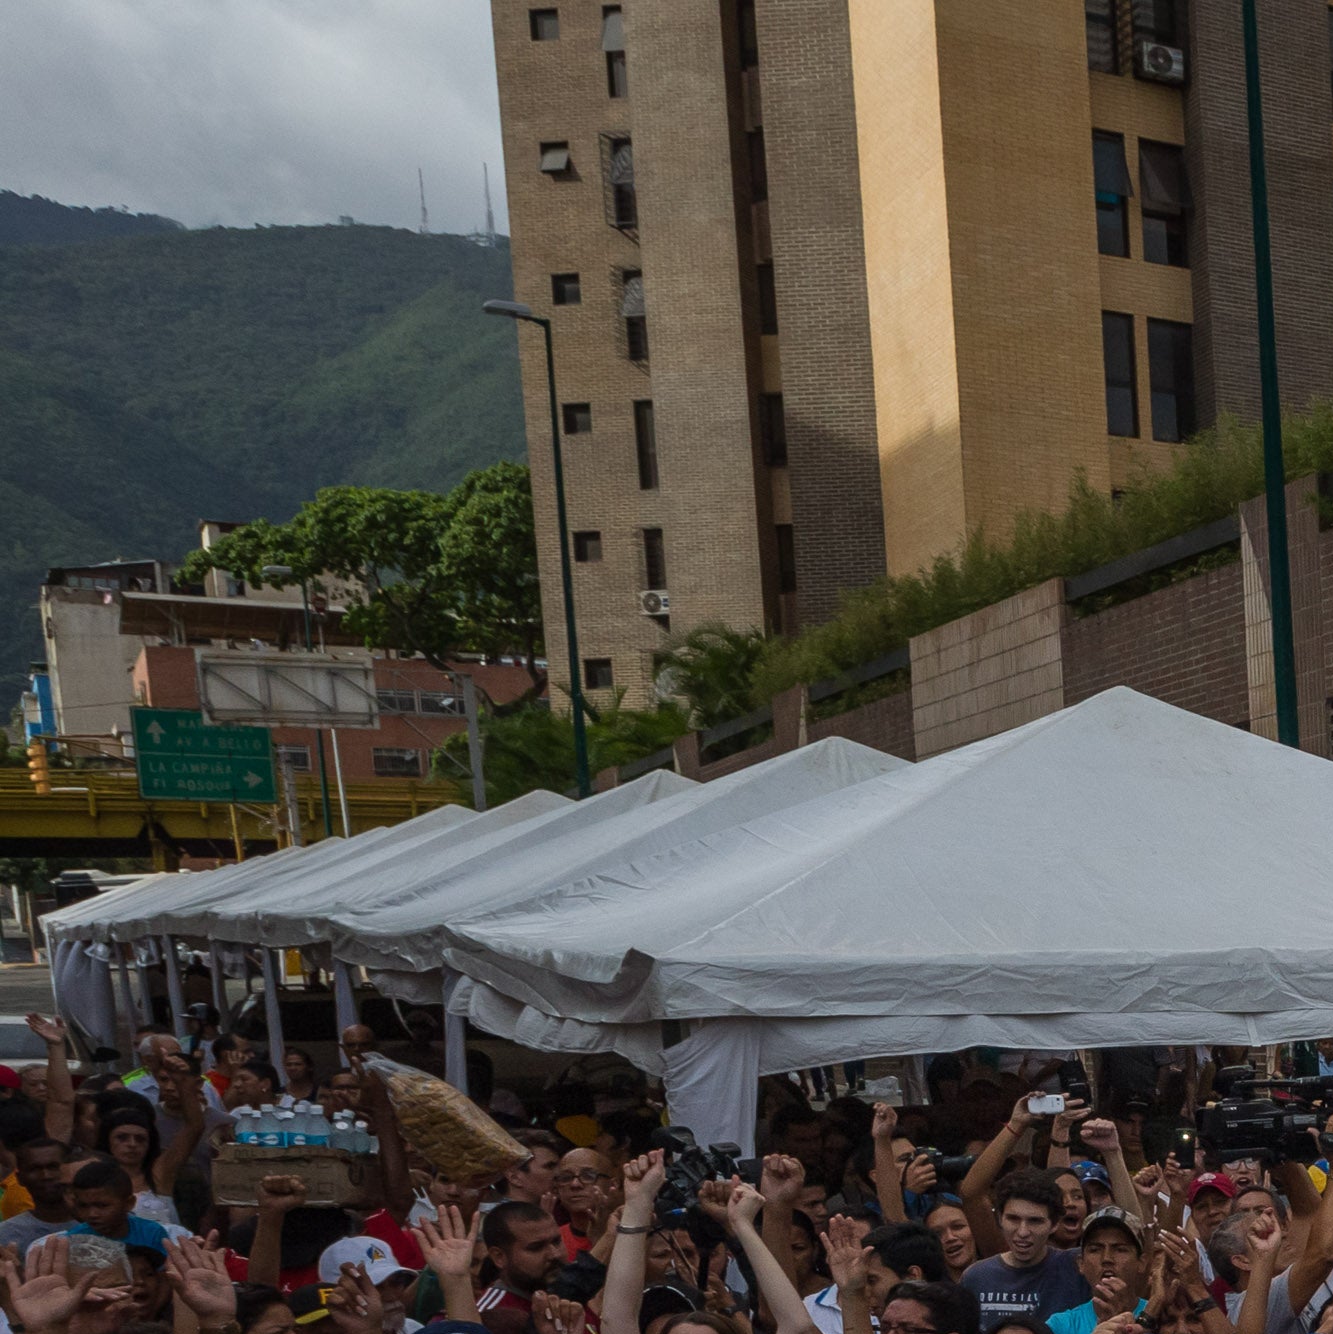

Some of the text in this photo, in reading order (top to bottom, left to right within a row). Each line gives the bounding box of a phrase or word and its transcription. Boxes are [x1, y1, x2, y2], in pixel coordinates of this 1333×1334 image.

[176, 737, 262, 750] AV A BELLO
[149, 760, 233, 775] LA CAMPIÑA
